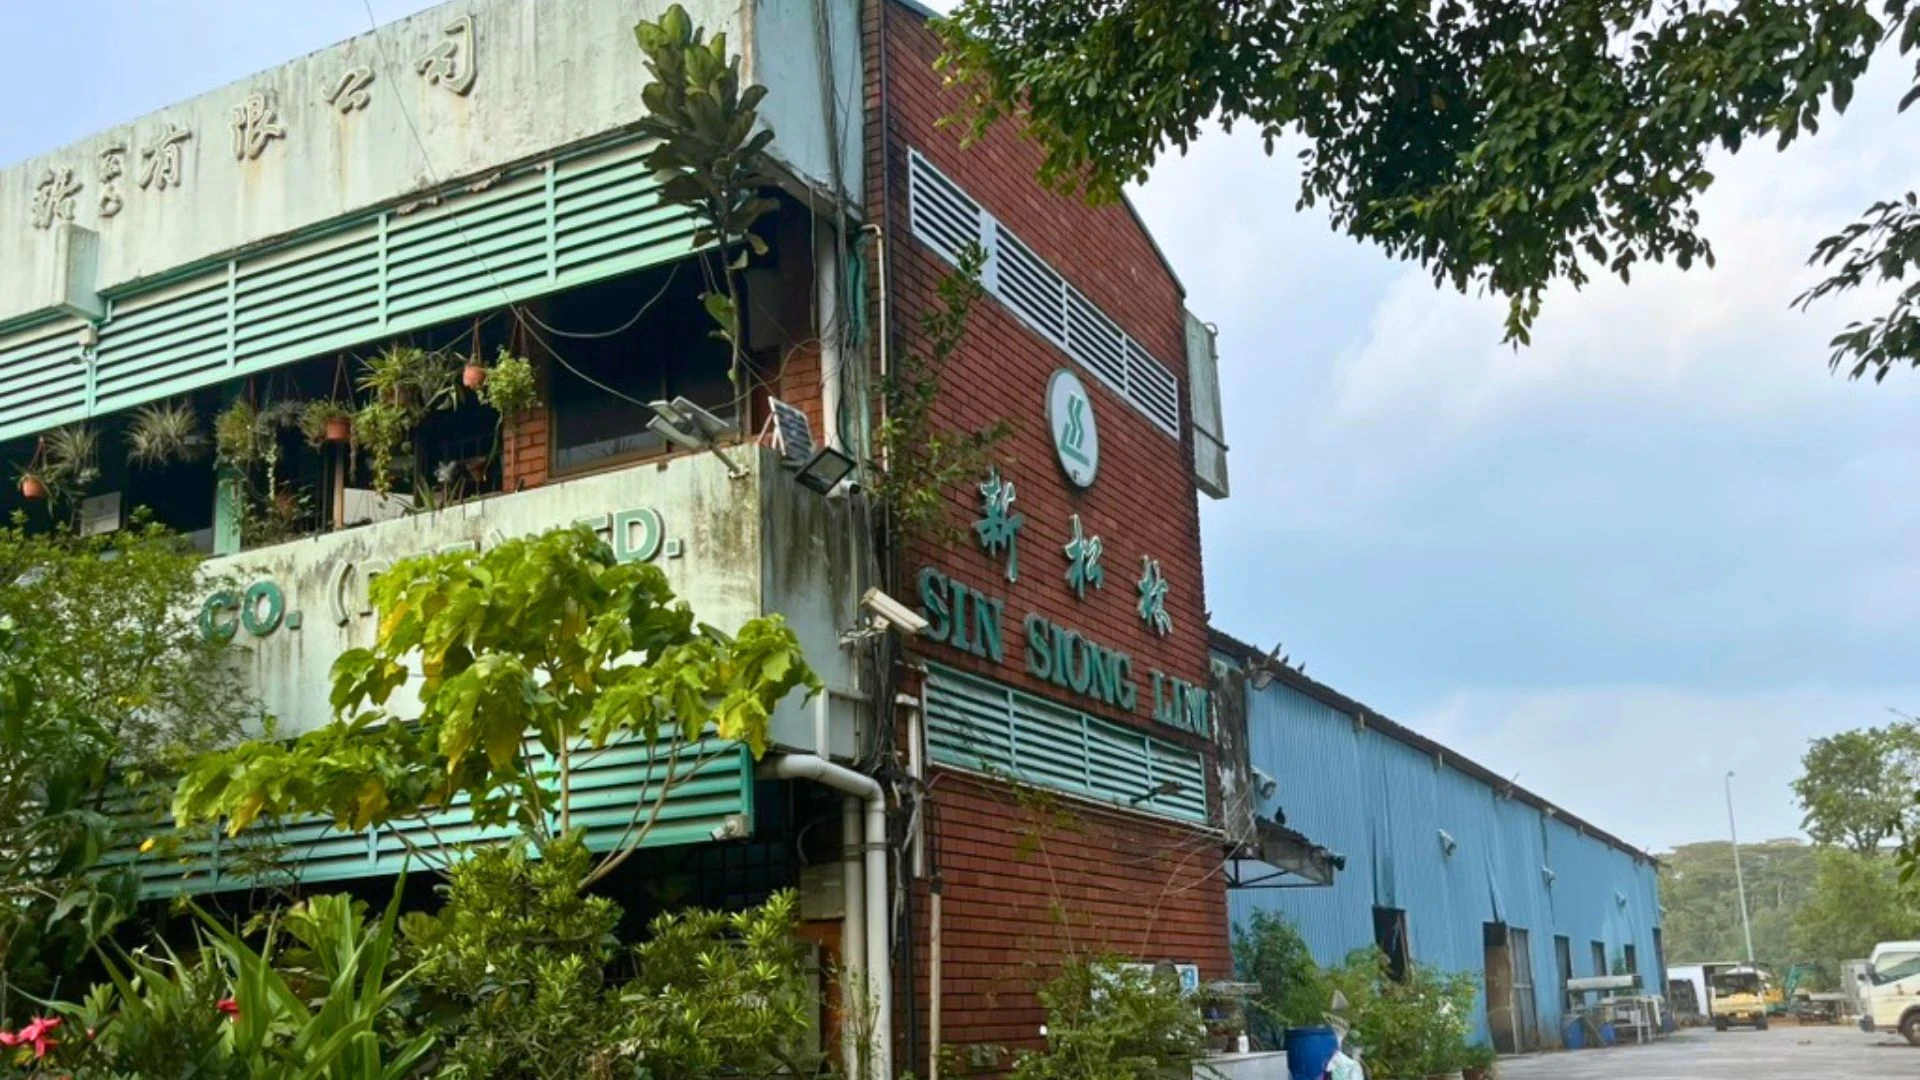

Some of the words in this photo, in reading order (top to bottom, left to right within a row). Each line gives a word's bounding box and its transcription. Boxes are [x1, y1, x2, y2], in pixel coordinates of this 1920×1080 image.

[199, 581, 303, 646] CO.
[916, 566, 1006, 663] SIN
[1022, 611, 1138, 712] SIONG
[1149, 667, 1209, 739] LIM
